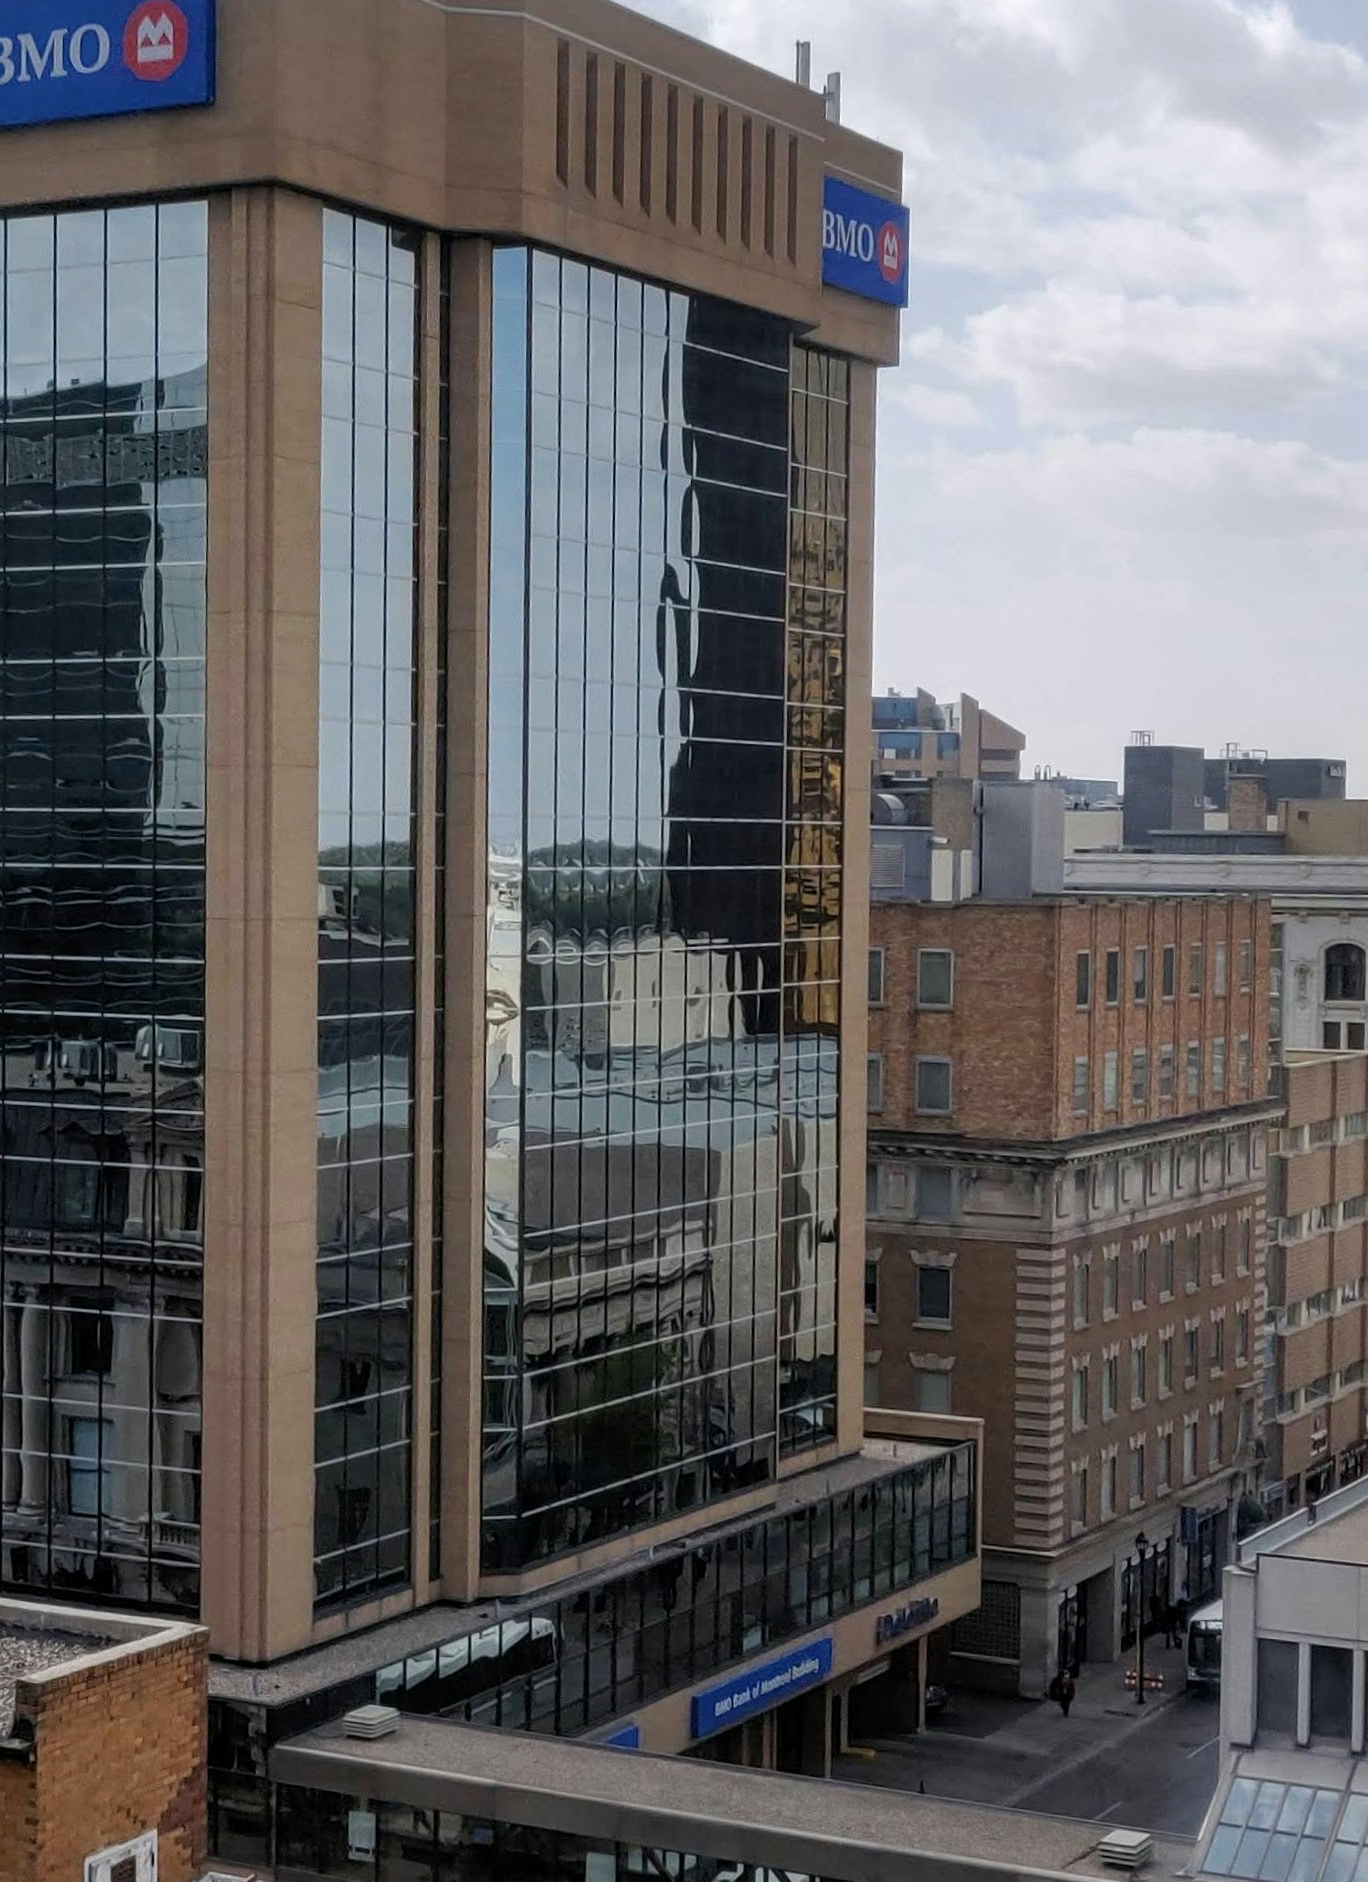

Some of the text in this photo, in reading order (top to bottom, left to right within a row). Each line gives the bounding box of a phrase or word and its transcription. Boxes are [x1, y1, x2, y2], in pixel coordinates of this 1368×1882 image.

[822, 208, 874, 262] BMO
[715, 1658, 819, 1717] BMO Bank of Montreal Building
